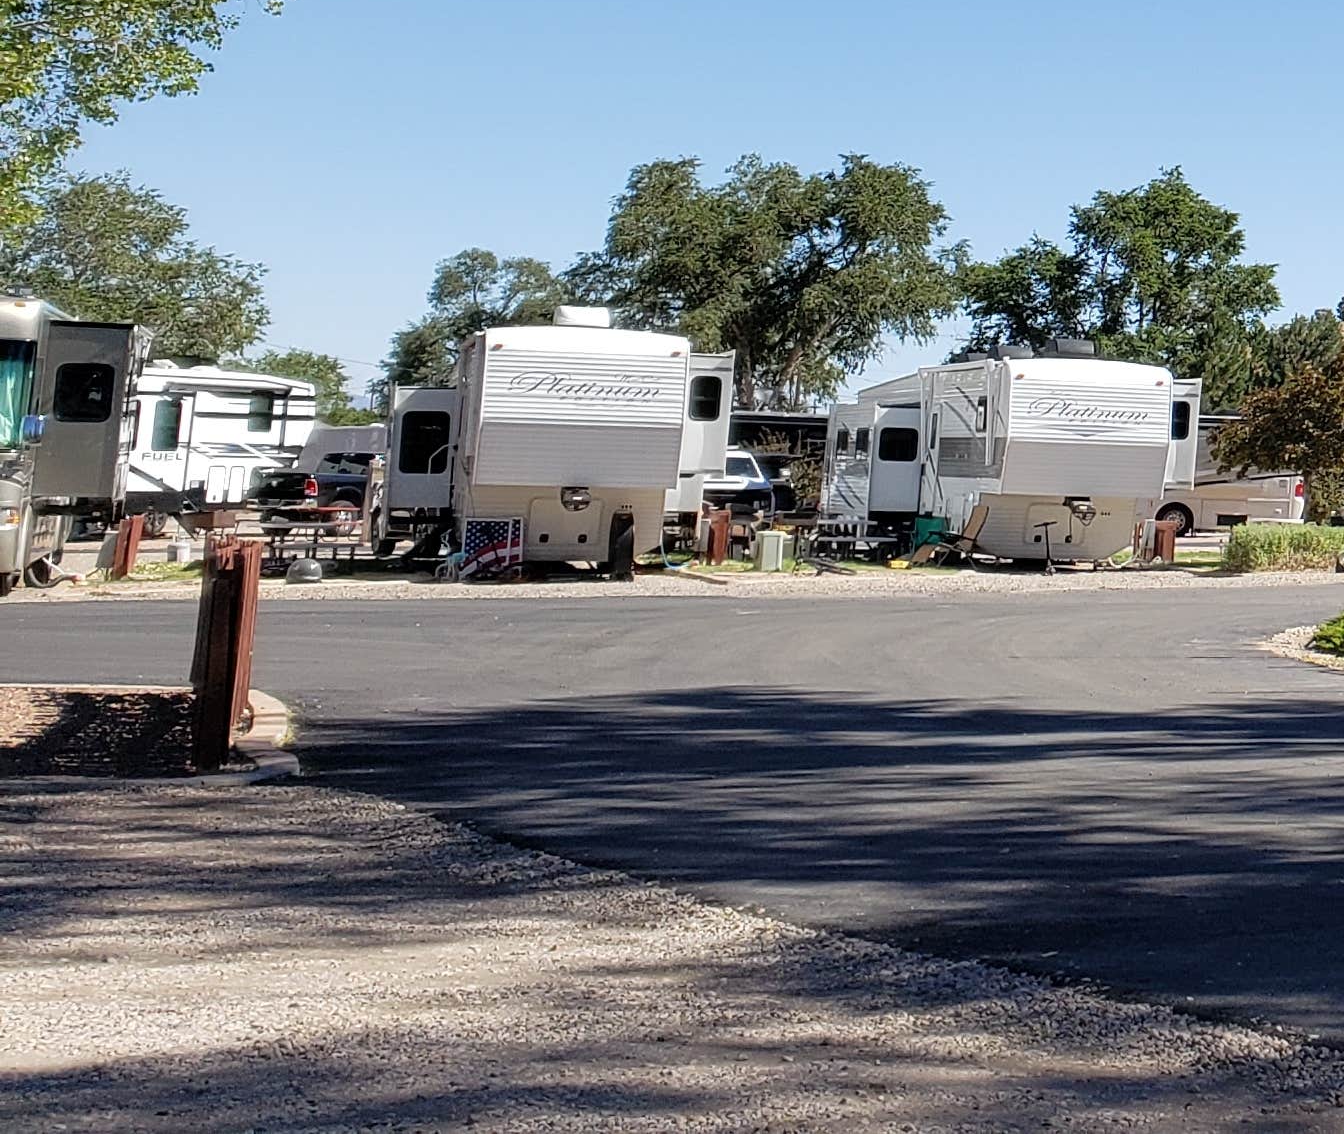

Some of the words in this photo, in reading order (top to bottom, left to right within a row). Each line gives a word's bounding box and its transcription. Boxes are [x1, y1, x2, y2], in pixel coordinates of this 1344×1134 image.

[507, 370, 660, 396] Platinum
[1027, 397, 1149, 420] Platinum
[141, 452, 182, 461] FUEL
